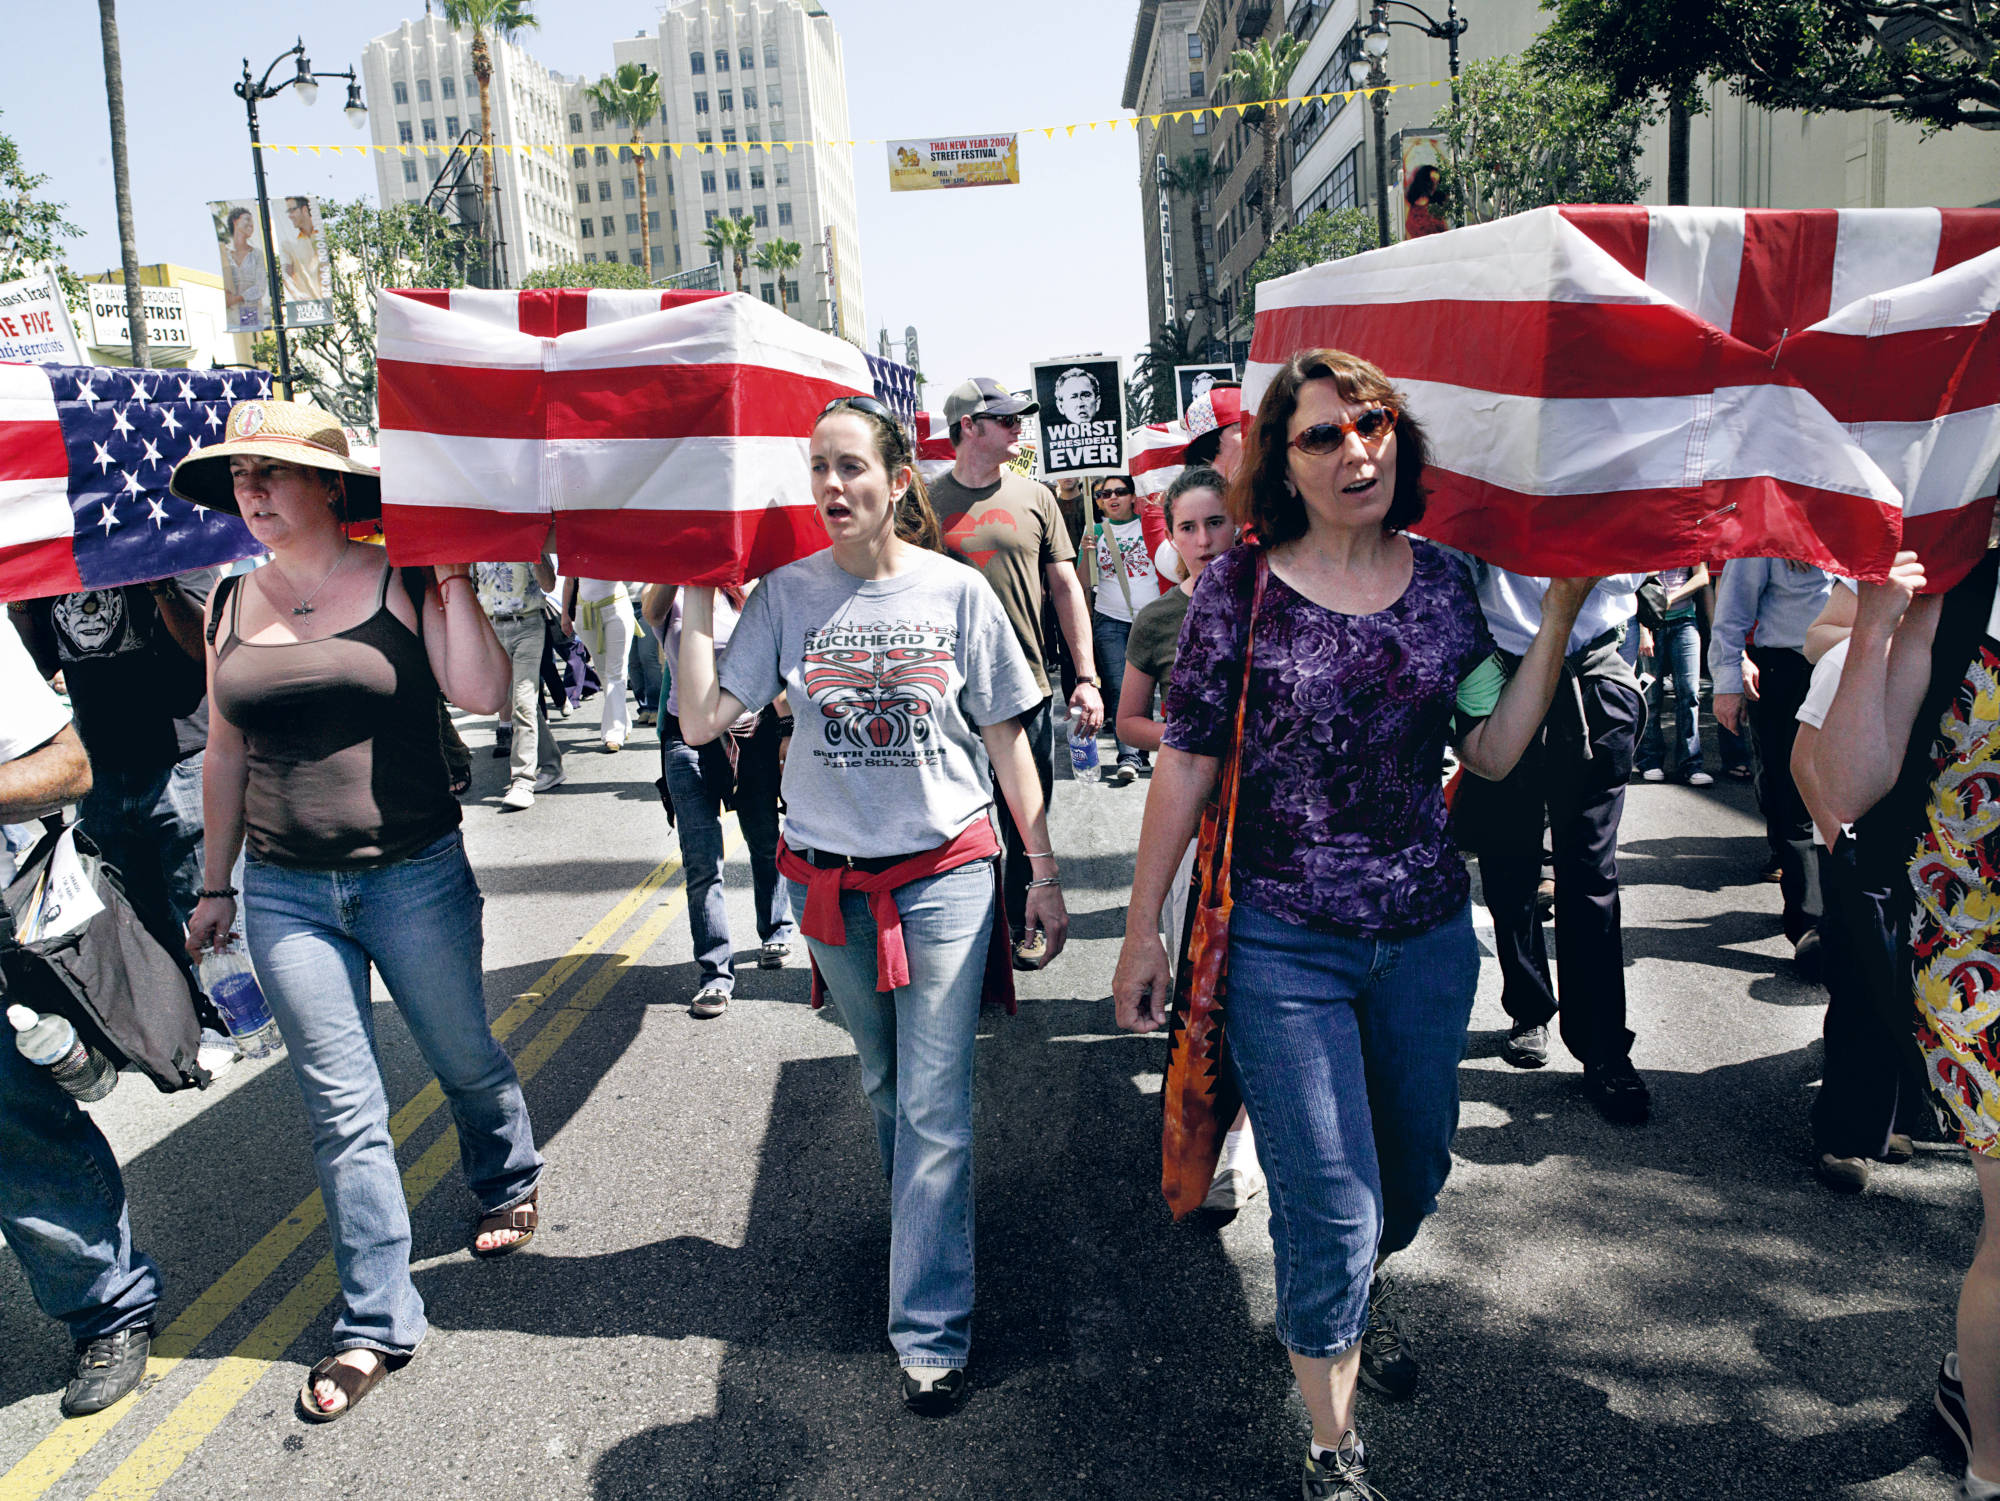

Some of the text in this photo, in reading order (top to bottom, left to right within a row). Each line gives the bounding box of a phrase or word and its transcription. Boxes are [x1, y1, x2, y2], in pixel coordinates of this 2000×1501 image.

[929, 137, 1010, 152] THAI NEW YEAR 2007
[930, 148, 997, 161] STREET FESTIVAL
[95, 303, 182, 321] OPTOETRIST
[20, 310, 54, 336] FIVE
[120, 327, 186, 342] 4-3131
[1046, 420, 1117, 441] WORST
[1049, 435, 1118, 450] PRESIDENT
[1049, 444, 1119, 469] EVER
[804, 624, 961, 640] RENEGADES
[803, 633, 925, 651] BUCKHEAD
[864, 758, 899, 768] 8th,
